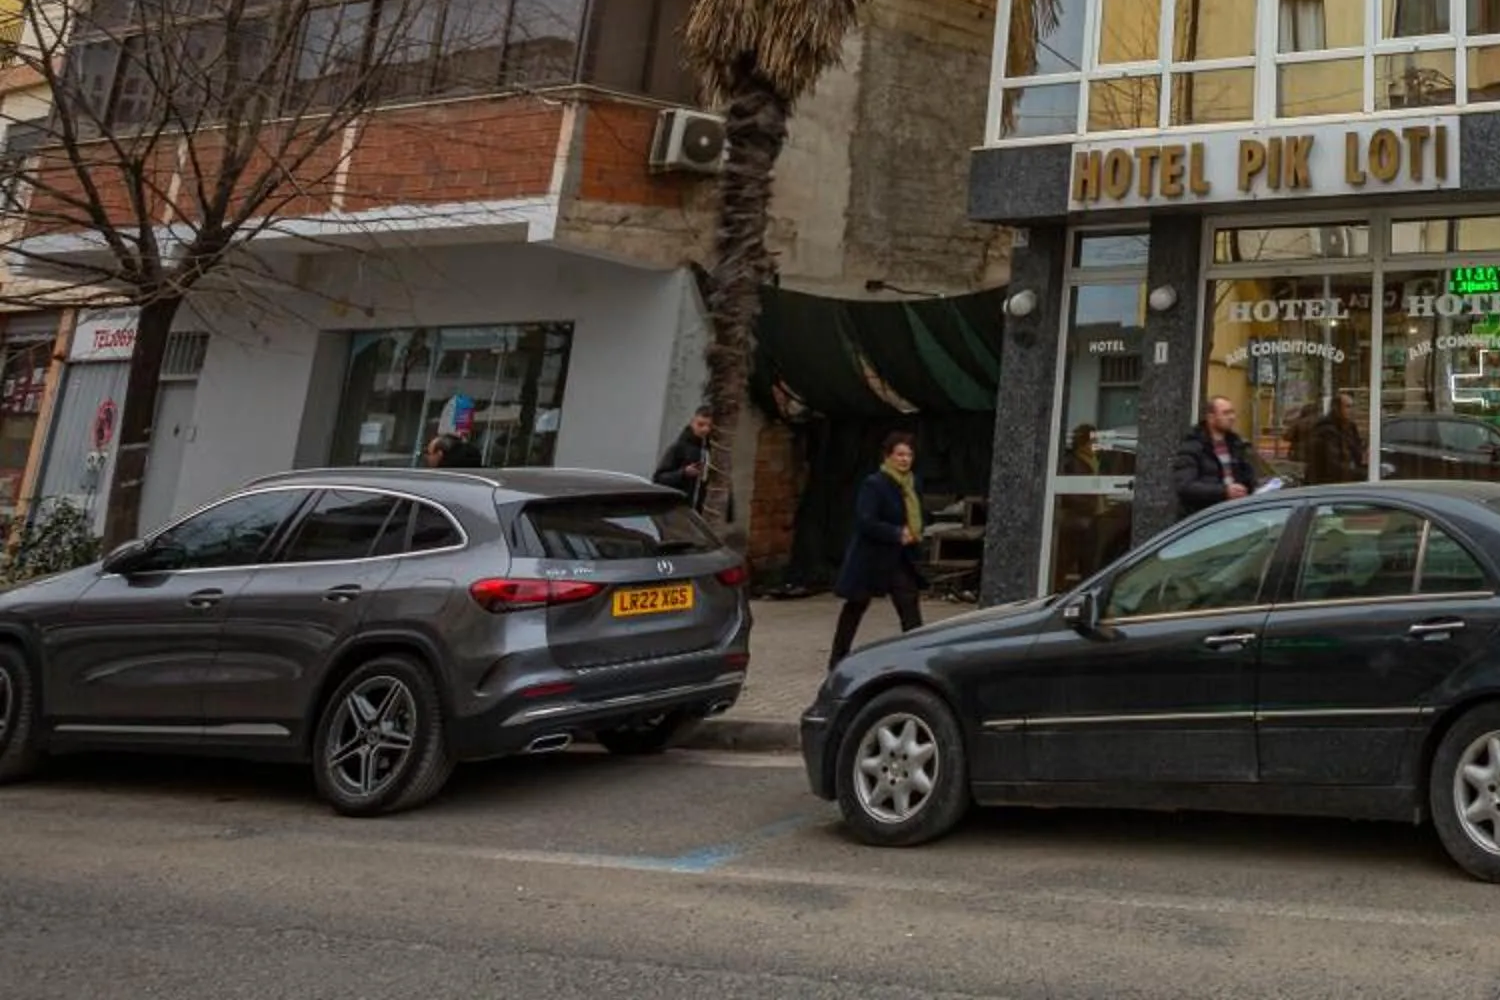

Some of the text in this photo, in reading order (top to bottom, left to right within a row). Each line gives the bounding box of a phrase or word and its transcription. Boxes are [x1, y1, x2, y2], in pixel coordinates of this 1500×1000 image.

[1072, 125, 1448, 203] HOTEL PIK LOTI
[1228, 298, 1349, 323] HOTEL
[1088, 339, 1126, 353] HOTEL
[1251, 340, 1345, 363] CONDITIONED
[1408, 341, 1433, 361] AIR
[619, 591, 659, 612] LR22
